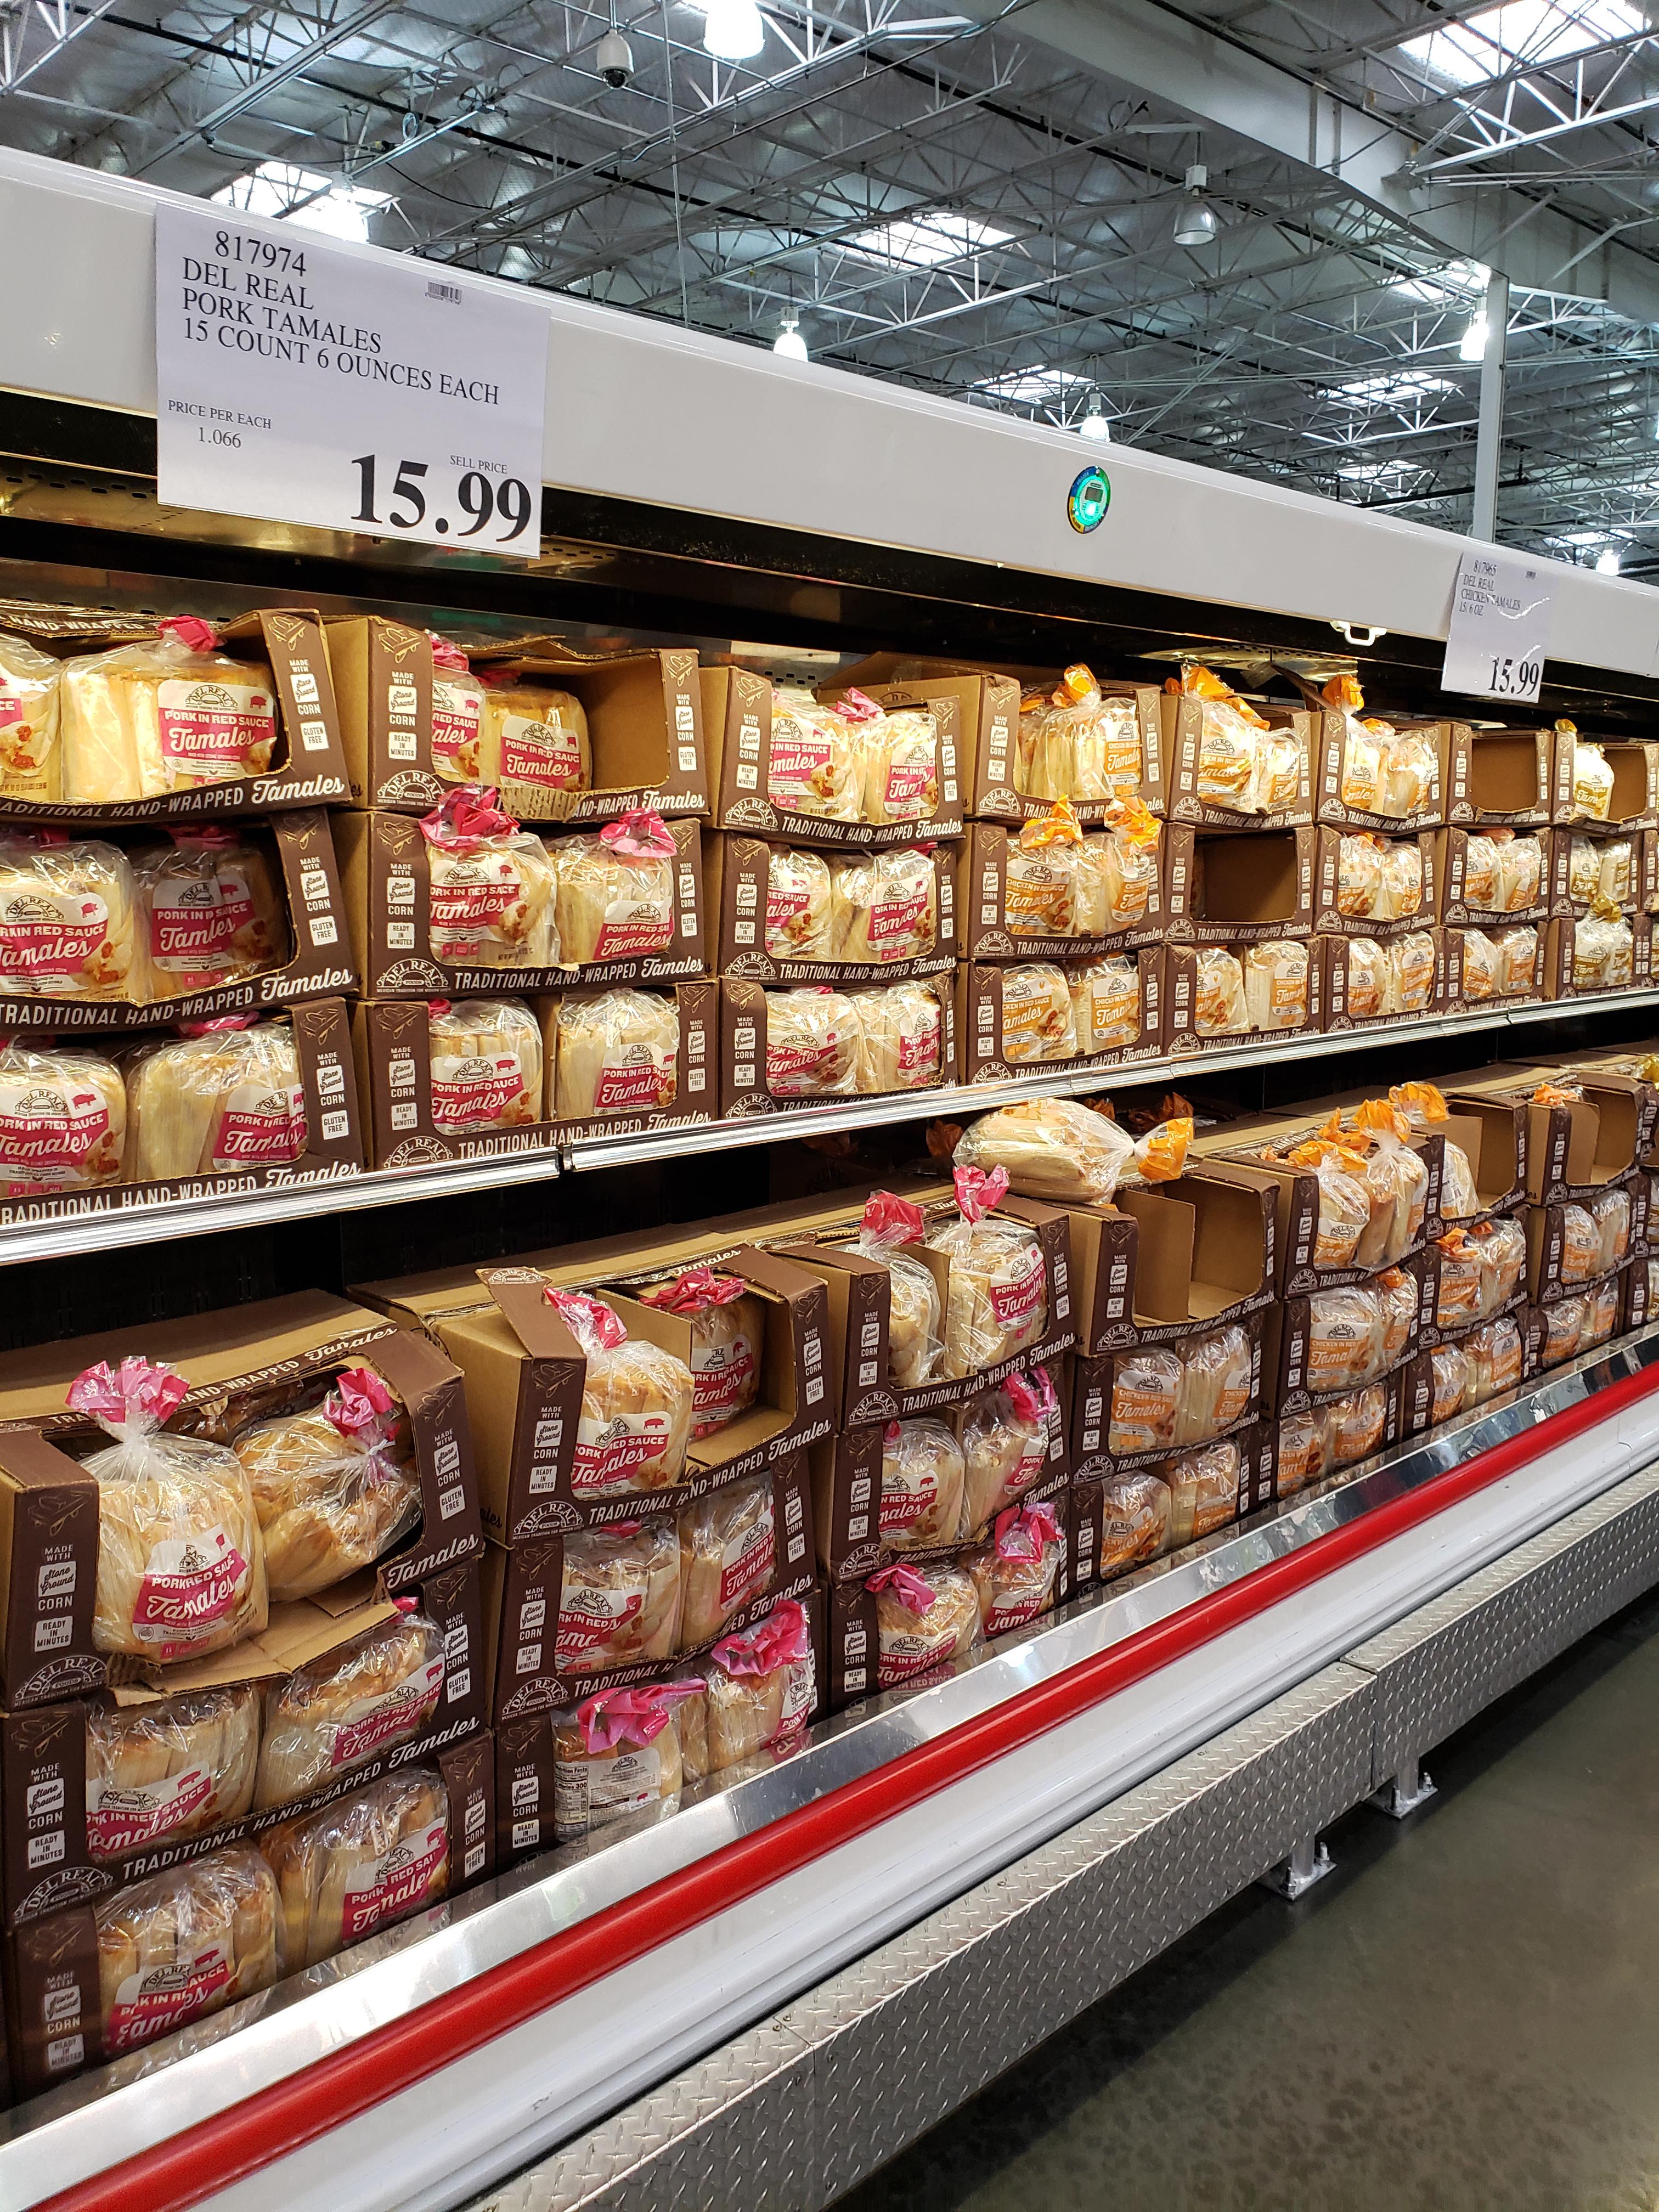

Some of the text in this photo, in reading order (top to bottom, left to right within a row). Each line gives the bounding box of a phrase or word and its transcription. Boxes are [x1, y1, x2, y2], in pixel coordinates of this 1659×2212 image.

[215, 231, 307, 276] 817974
[182, 257, 315, 309] DEL REAL
[182, 287, 382, 353] PORK TAMALES
[183, 318, 500, 405] 15 COUNT 6 OUNCES EACH
[168, 399, 272, 430] PRICE PER EACH
[198, 427, 242, 449] 1.066
[450, 455, 507, 475] SELL PRICE
[351, 454, 532, 543] 15.99
[1463, 574, 1494, 591] DEL REAL
[1469, 603, 1473, 613] 6
[1474, 605, 1483, 616] OZ
[1488, 657, 1539, 696] 15.99
[297, 704, 321, 715] CORN
[165, 710, 269, 729] PORK IN RED SAUCE
[389, 715, 415, 726] CORN
[454, 716, 477, 729] SAUCE
[303, 726, 324, 737] GLUTEN
[168, 729, 255, 752] Tamales
[308, 735, 323, 744] FREE
[505, 740, 528, 752] PORK
[739, 749, 758, 760] CORN
[785, 744, 800, 752] RED
[506, 754, 572, 776] Tamales
[110, 775, 345, 817] HAND-WRAPPED Tamales
[642, 790, 705, 810] Tamales
[782, 816, 962, 843] TRADITIONAL HAND-WRAPPED Tamales
[454, 887, 486, 896] IN RED
[785, 894, 808, 902] SAUCE
[306, 900, 330, 911] CORN
[388, 905, 414, 915] CORN
[737, 907, 755, 916] CORN
[157, 910, 193, 919] PORK
[33, 923, 105, 937] RED SAUCE
[312, 921, 333, 932] GLUTEN
[606, 923, 657, 933] PORK IN RED
[317, 929, 331, 939] FREE
[601, 934, 669, 957] Tamales
[1017, 928, 1164, 955] TRADITIONAL HAND-WRAPPED Tamales
[455, 955, 703, 989] TRADITIONAL HAND-WRAPPED Tamales
[780, 955, 956, 979] TRADITIONAL HAND-WRAPPED Tamales
[125, 969, 352, 1025] HAND-WRAPPED Tamales
[1122, 1045, 1161, 1063] Tamales
[603, 1068, 651, 1078] PORK IN RED
[391, 1087, 415, 1097] CORN
[431, 1082, 459, 1094] PORK
[602, 1075, 664, 1103] Tamales
[320, 1094, 345, 1107] CORN
[27, 1114, 104, 1130] IN RED SAUCE
[228, 1115, 260, 1127] PORK
[324, 1116, 346, 1126] GLUTEN
[328, 1124, 343, 1132] FREE
[459, 1132, 545, 1159] TRADITIONAL
[673, 1250, 742, 1276] Tamales
[1109, 1284, 1125, 1293] CORN
[861, 1348, 878, 1356] CORN
[805, 1362, 822, 1375] CORN
[902, 1333, 1076, 1412] TRADITIONAL Tamales
[628, 1436, 664, 1447] SAUCE
[534, 1448, 558, 1458] CORN
[589, 1419, 831, 1525] TRADITIONAL Tamales
[437, 1471, 461, 1487] CORN
[531, 1481, 554, 1489] MINUTES
[1025, 1473, 1069, 1505] Tamales
[441, 1492, 463, 1505] GLUTEN
[889, 1491, 933, 1503] RED SAUCE
[850, 1502, 868, 1512] CORN
[44, 1545, 74, 1557] MADE
[46, 1553, 71, 1562] WITH
[387, 1533, 479, 1589] Tamales
[45, 1567, 70, 1581] Stone
[41, 1576, 74, 1594] Ground
[38, 1596, 73, 1610] CORN
[42, 1622, 67, 1633] READY
[49, 1629, 58, 1638] IN
[37, 1635, 71, 1647] MINUTES
[520, 1629, 543, 1640] CORN
[574, 1575, 812, 1696] TRADITIONAL Tamales
[521, 1648, 538, 1657] READY
[447, 1653, 469, 1669] CORN
[517, 1660, 540, 1671] MINUTES
[845, 1655, 865, 1664] CORN
[449, 1674, 470, 1688] GLUTEN
[123, 1718, 479, 1880] TRADITIONAL HAND-WRAPPED Tamales
[162, 1783, 205, 1815] SAUCE
[513, 1804, 538, 1816] CORN
[29, 1812, 63, 1829] CORN
[34, 1835, 59, 1849] READY
[515, 1836, 538, 1845] MINUTES
[30, 1849, 65, 1863] MINUTES
